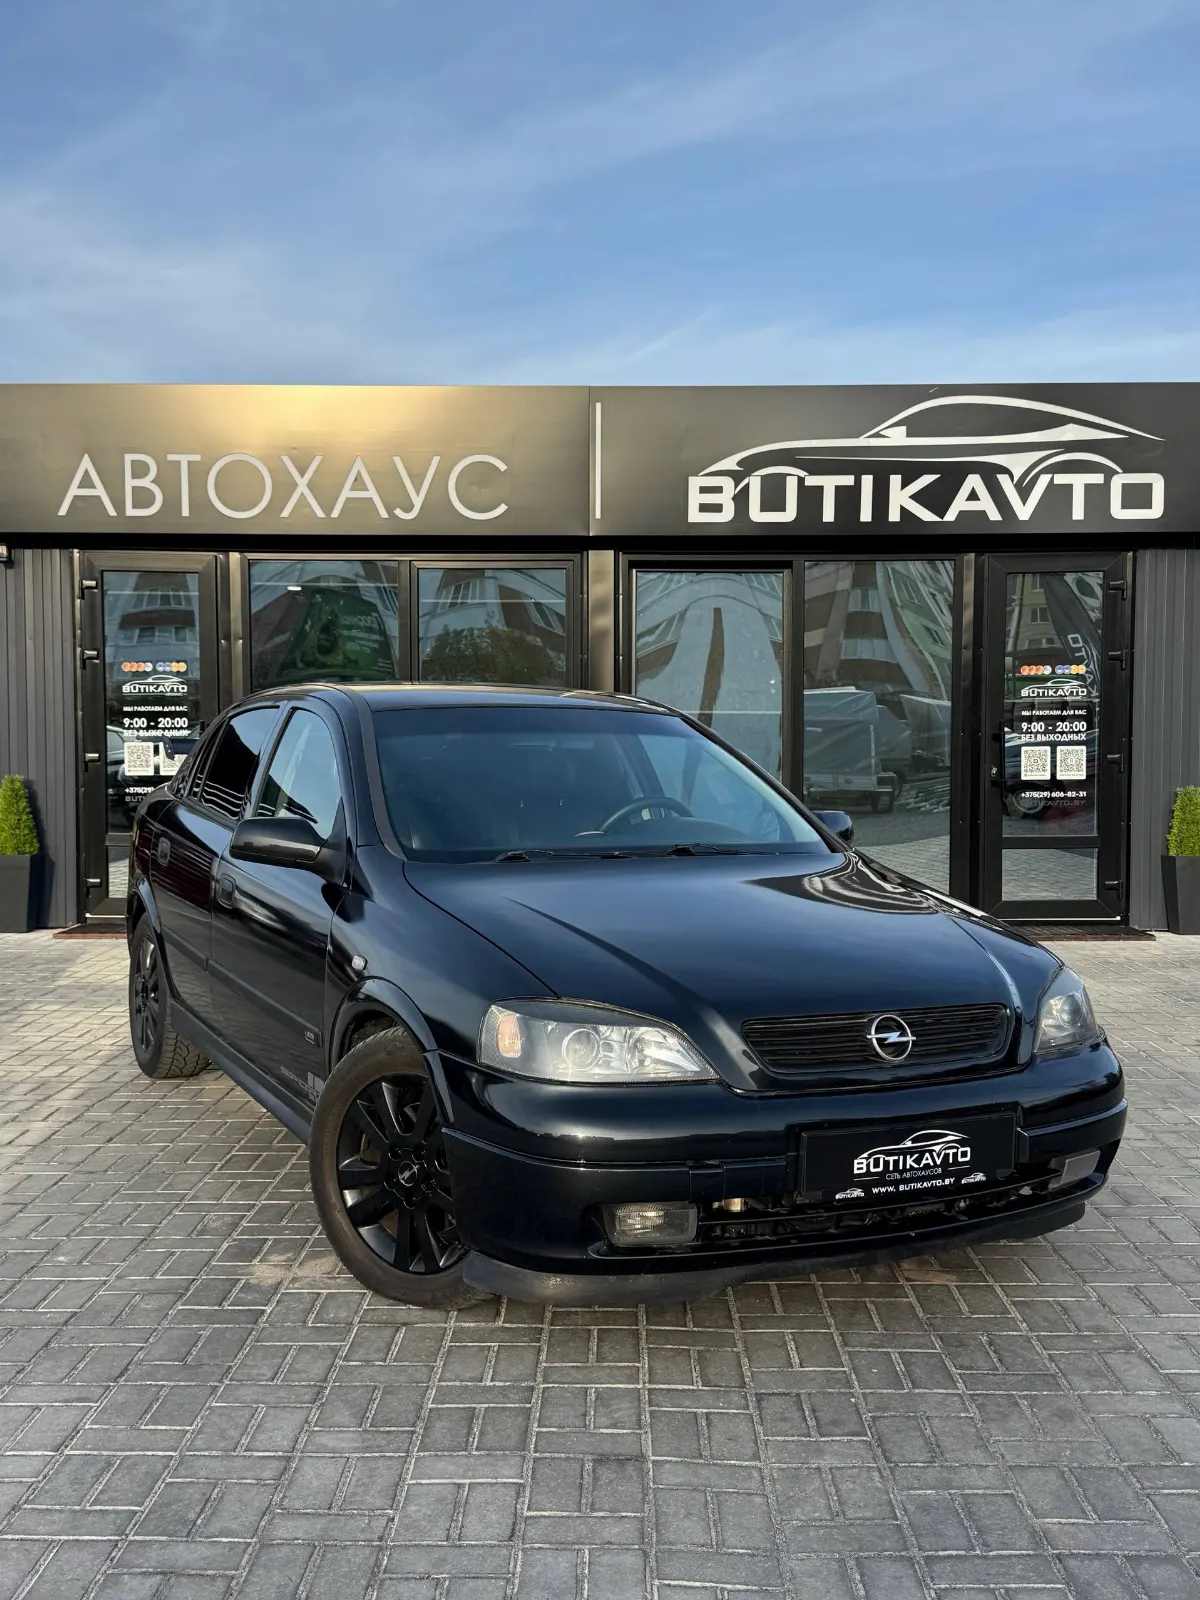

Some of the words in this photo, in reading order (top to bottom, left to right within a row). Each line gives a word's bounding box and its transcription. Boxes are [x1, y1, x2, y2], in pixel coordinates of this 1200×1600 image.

[57, 452, 509, 521] АВТОХАУС
[687, 472, 1165, 523] BUTIKAVTO
[122, 684, 188, 693] BUTIKAVTO
[1021, 688, 1087, 697] BUTIKAVTO
[123, 717, 147, 728] 9:00
[157, 717, 188, 728] 20:00
[1021, 722, 1045, 732] 9:00
[1056, 721, 1087, 732] 20:00
[123, 729, 137, 737] БЕЗ
[138, 729, 189, 737] ВЫХОДНЫХ
[1021, 733, 1034, 741] БЕЗ
[1037, 733, 1087, 742] ВЫХОДНЫХ
[1021, 791, 1050, 799] +375(29)
[853, 1146, 971, 1175] BUTIKAVTO
[885, 1172, 901, 1181] СЕТЬ
[901, 1167, 943, 1179] АВТОХАУСОВ
[872, 1185, 896, 1195] WWW.
[899, 1177, 955, 1192] BUTIKAVTO.BY
